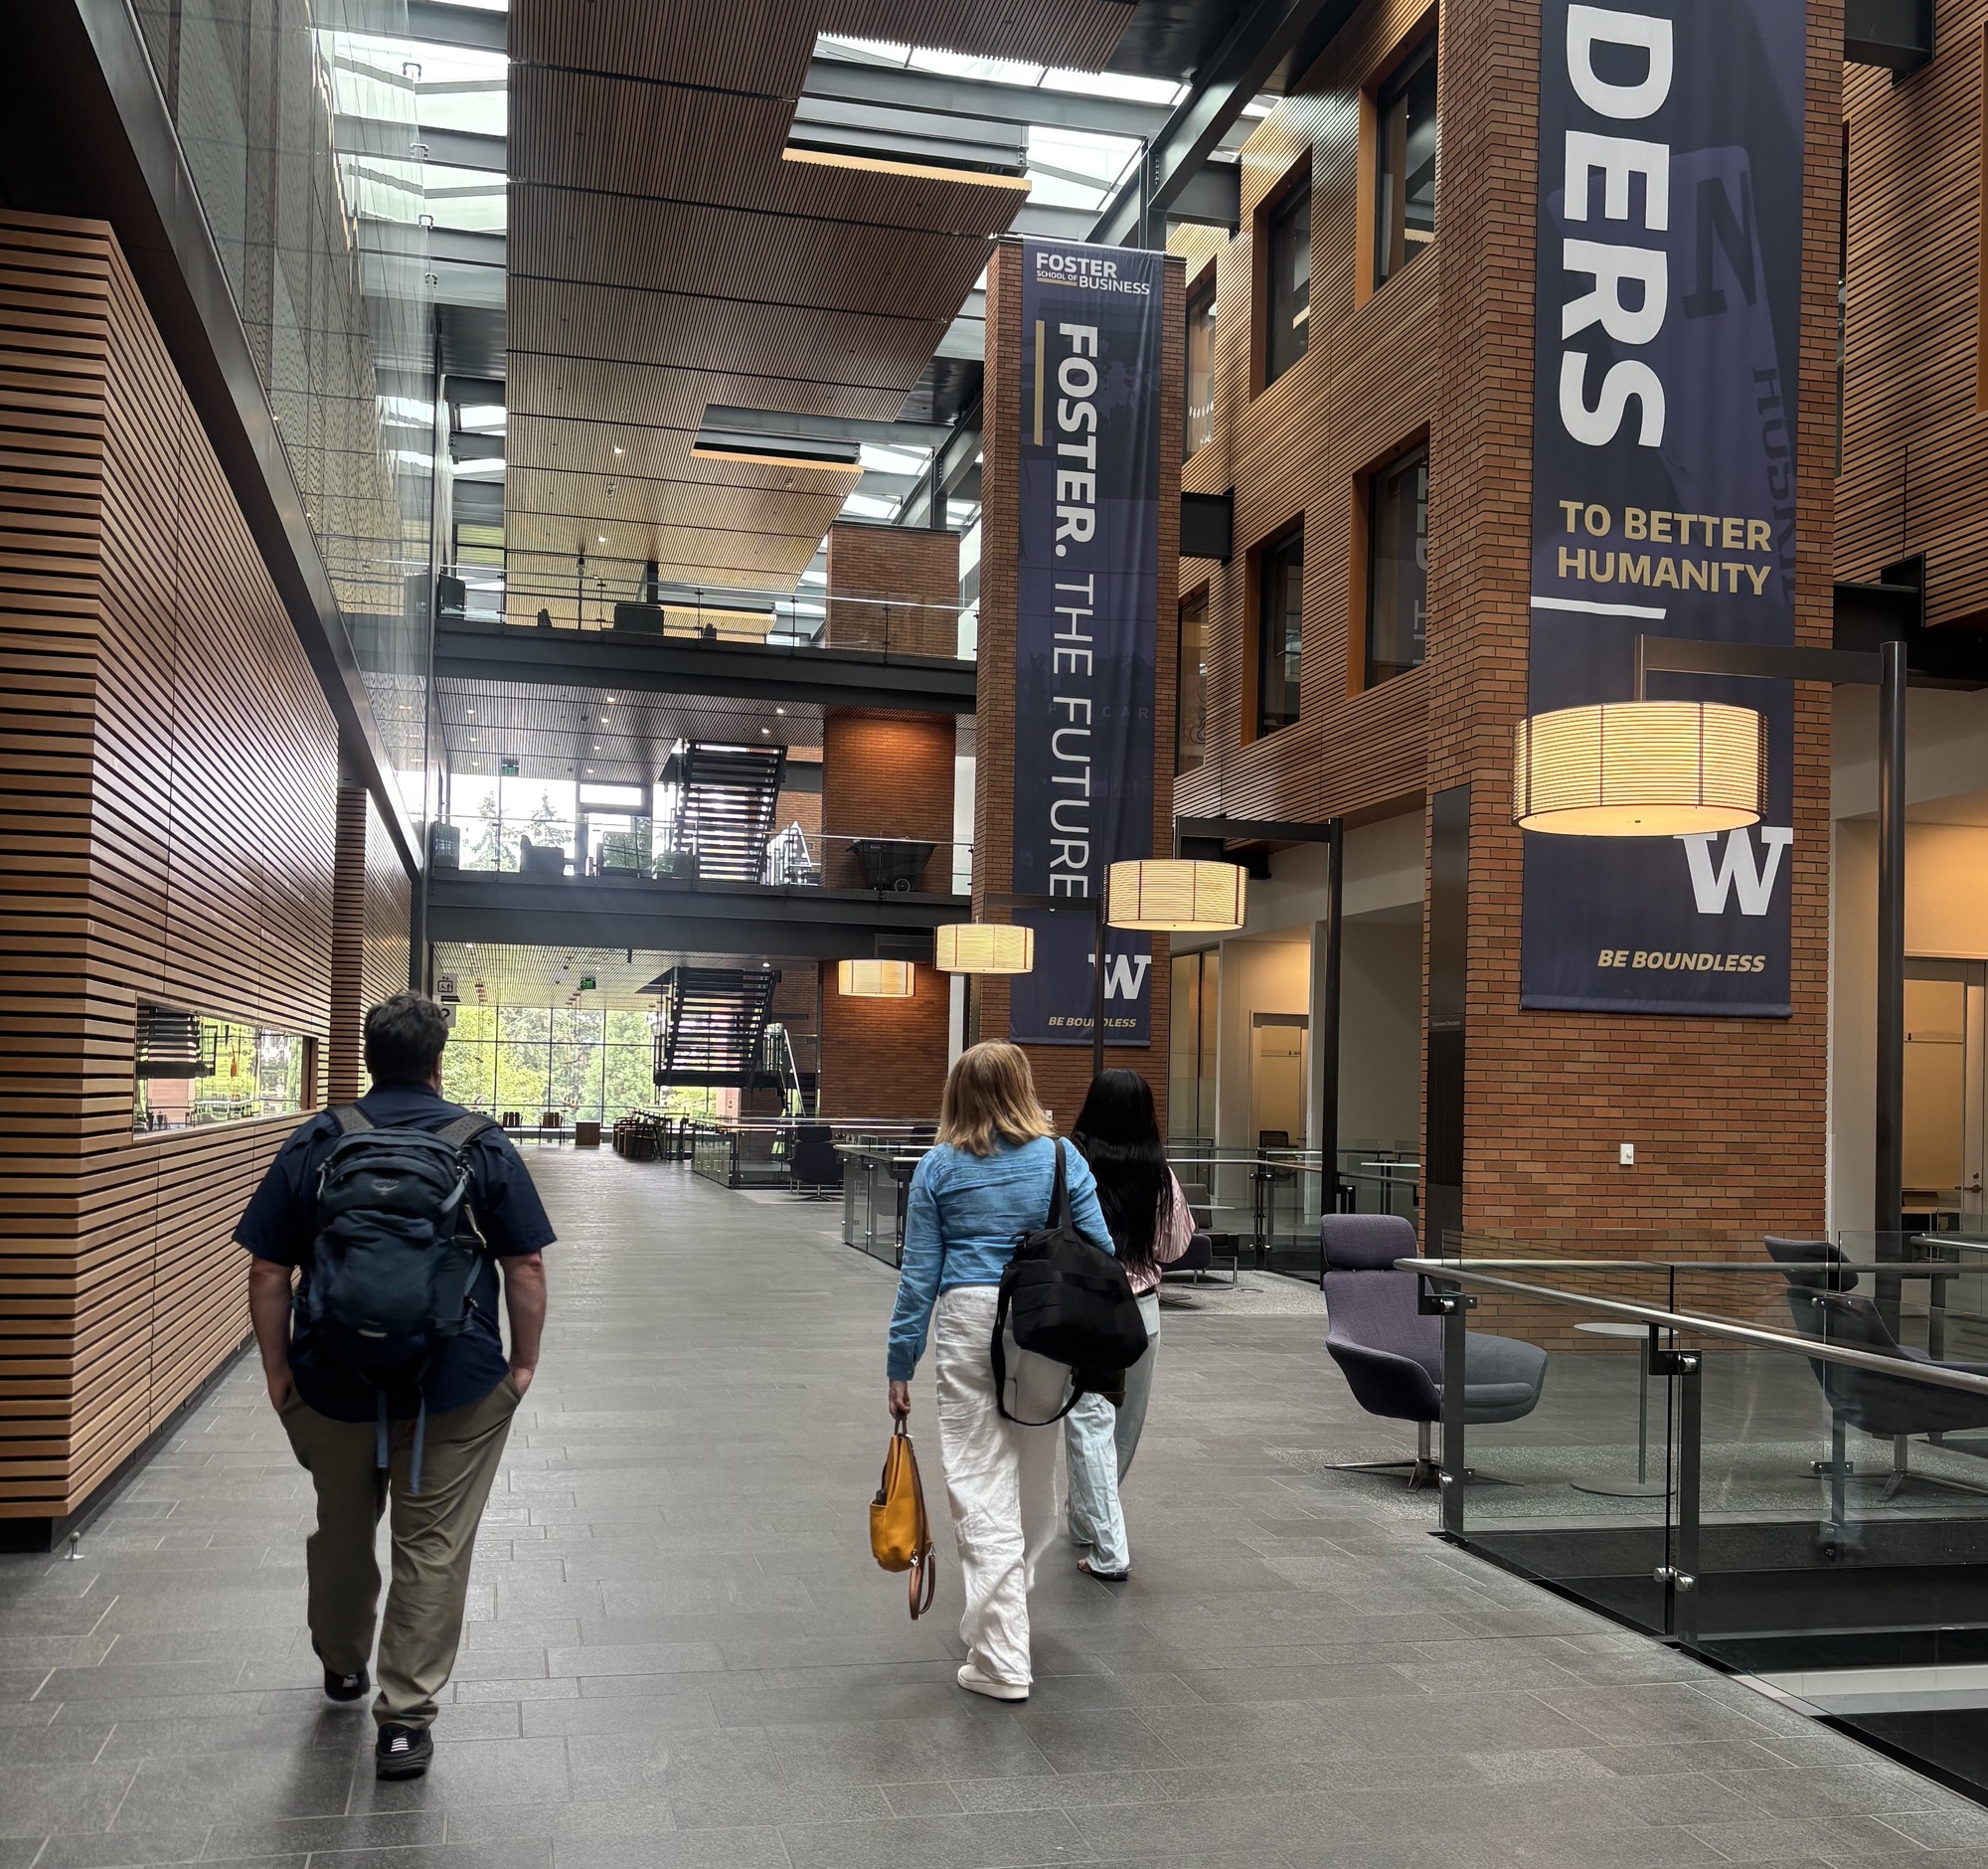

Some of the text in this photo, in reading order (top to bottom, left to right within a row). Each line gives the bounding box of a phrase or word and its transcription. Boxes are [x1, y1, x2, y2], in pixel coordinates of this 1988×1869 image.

[1559, 4, 1673, 447] DERS
[1036, 252, 1117, 279] FOSTER
[1036, 270, 1067, 280] SCHOOL
[1078, 275, 1150, 295] BUSINESS
[1055, 322, 1098, 558] FOSTER.
[1559, 500, 1772, 552] TO BETTER
[1558, 546, 1772, 595] HUMANITY
[1054, 574, 1094, 676] THE
[1673, 825, 1793, 916] W
[1087, 953, 1152, 1000] W
[1597, 949, 1766, 973] BE BOUNDLESS
[1048, 1016, 1064, 1027] BE
